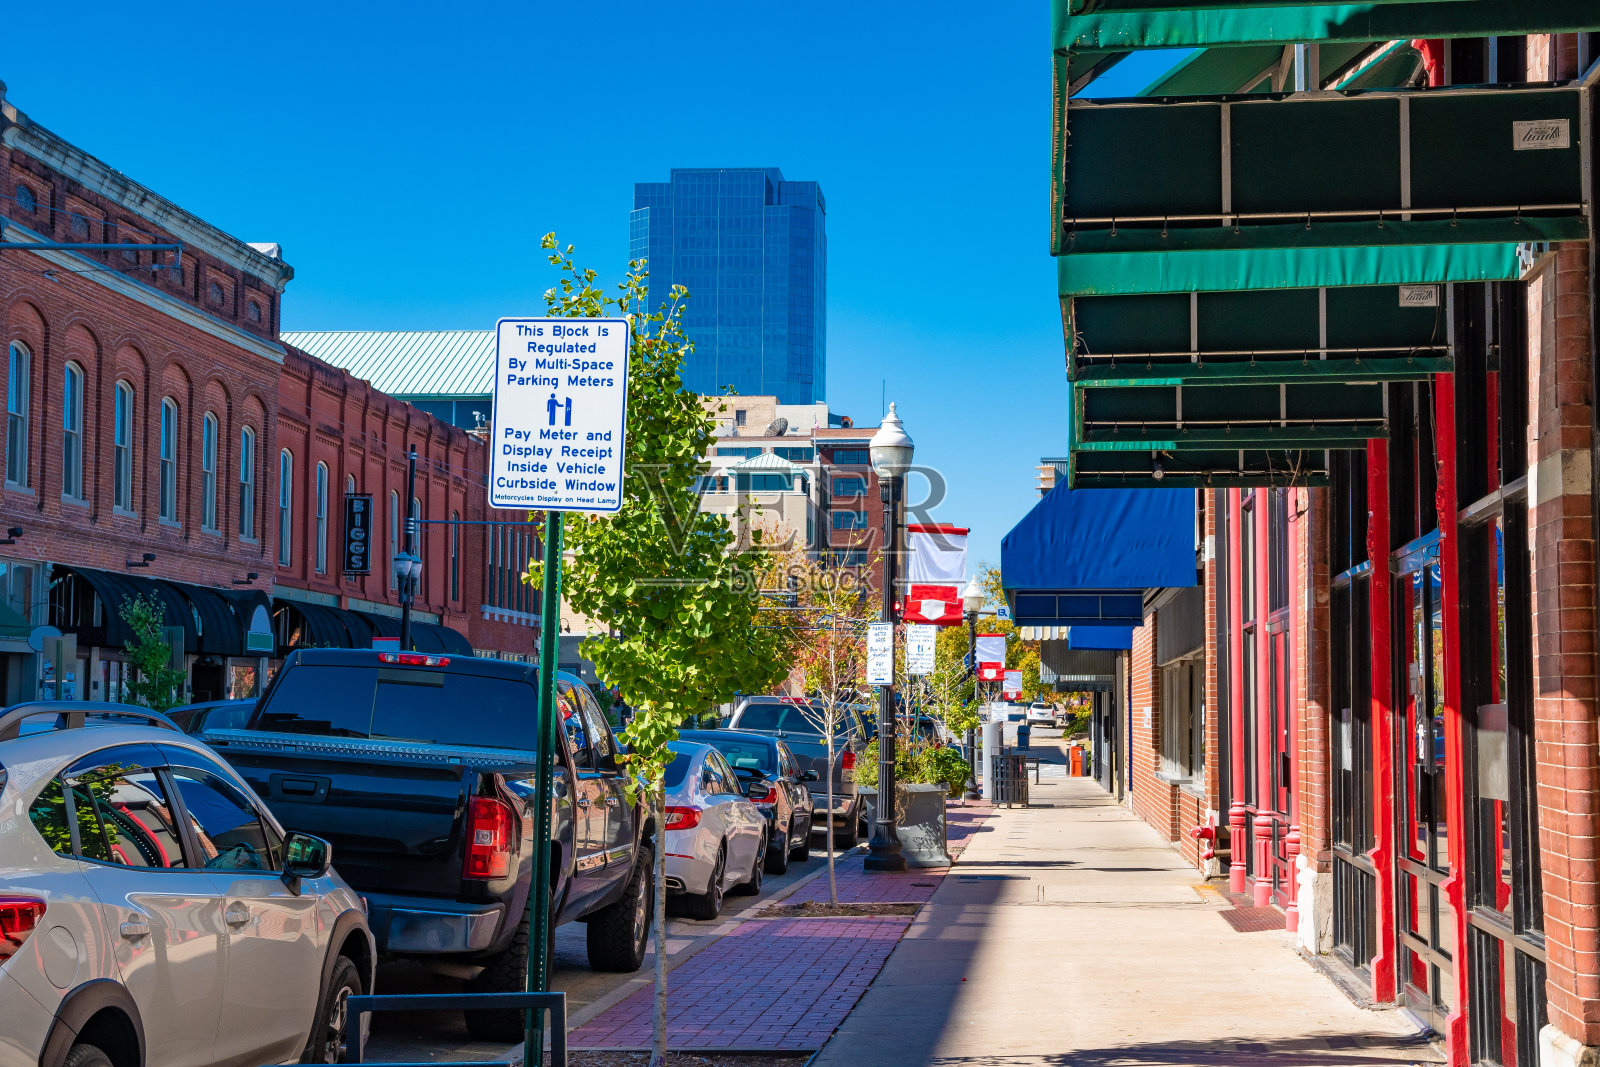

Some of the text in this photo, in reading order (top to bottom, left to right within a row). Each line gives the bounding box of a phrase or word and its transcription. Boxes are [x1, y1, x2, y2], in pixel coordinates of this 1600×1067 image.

[516, 325, 609, 337] This Block Is
[528, 342, 596, 356] Regulated
[509, 358, 614, 372] By Multi-Space
[507, 375, 614, 389] Parking Meters
[505, 428, 612, 441] Pay Meter and
[503, 444, 612, 460] Display Receipt
[507, 461, 605, 474] Inside Vehicle
[497, 477, 615, 491] Curbside Window
[350, 500, 365, 569] BIGGS
